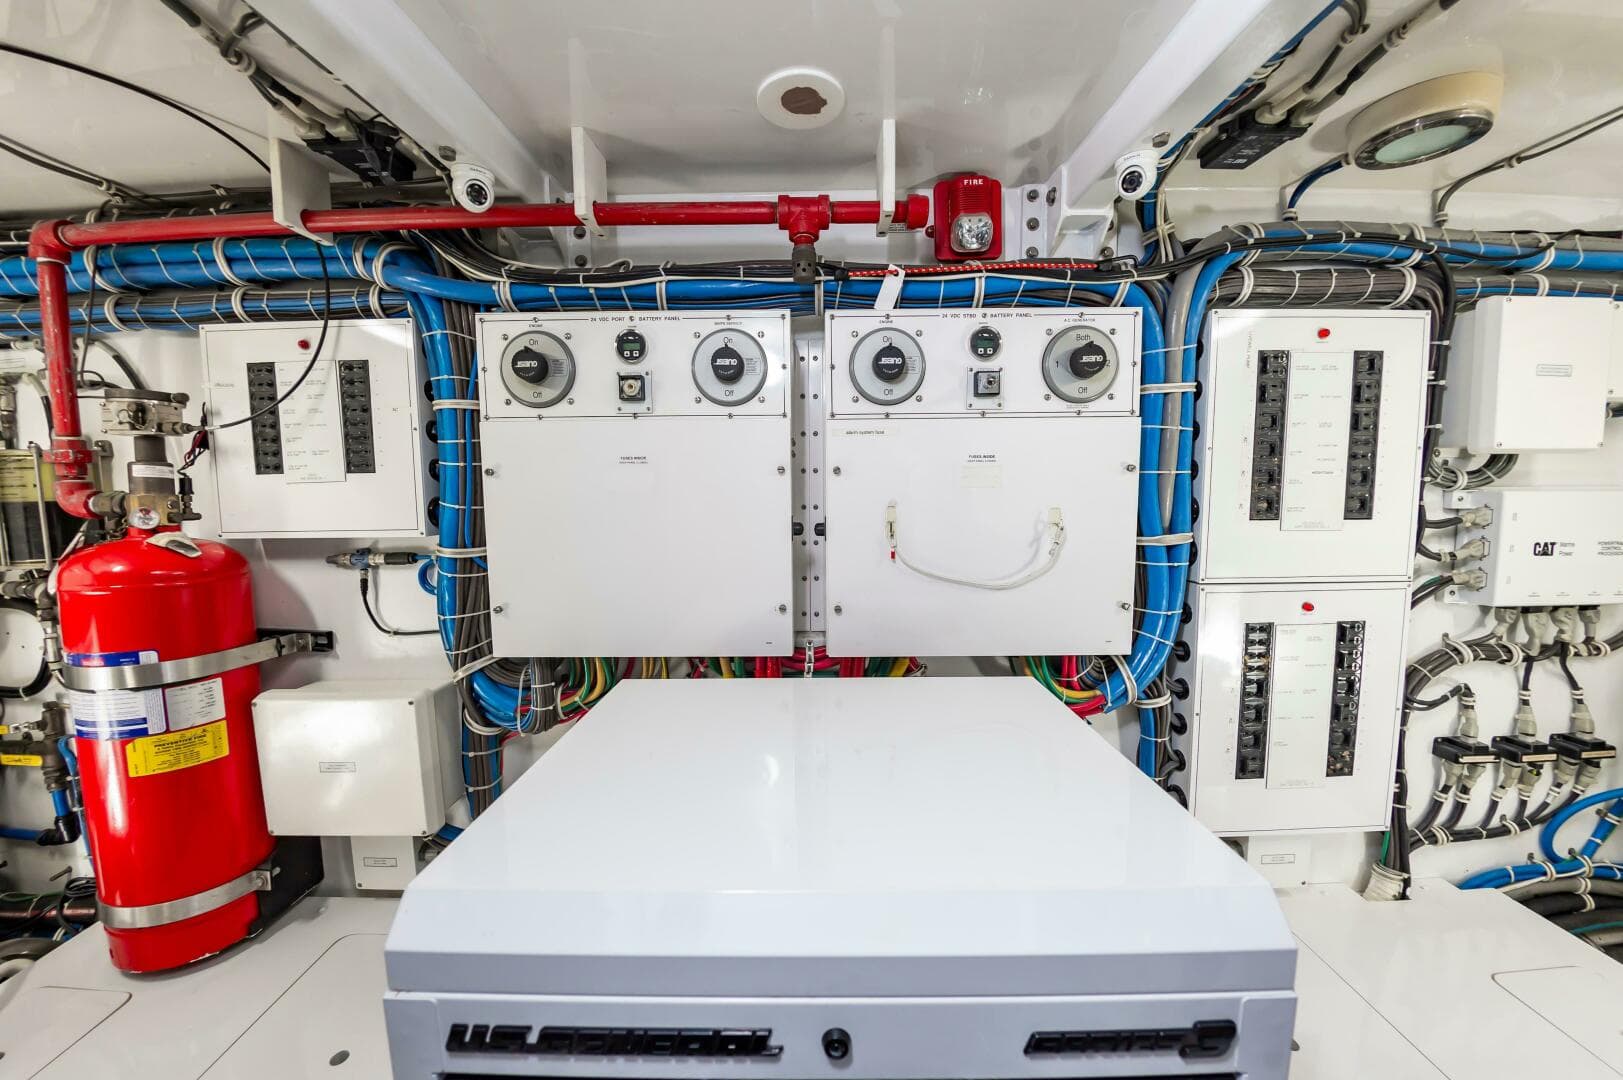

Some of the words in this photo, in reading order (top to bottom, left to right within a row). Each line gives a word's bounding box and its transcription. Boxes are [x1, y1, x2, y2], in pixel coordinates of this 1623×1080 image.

[963, 178, 984, 186] FIRE
[723, 336, 733, 344] On
[882, 335, 893, 343] On
[1076, 333, 1091, 342] Both
[528, 338, 539, 346] On
[1055, 360, 1060, 368] 1
[724, 389, 735, 397] Off
[883, 388, 894, 396] Off
[1077, 386, 1088, 394] Off
[532, 391, 543, 399] Off
[1533, 541, 1557, 557] CAT
